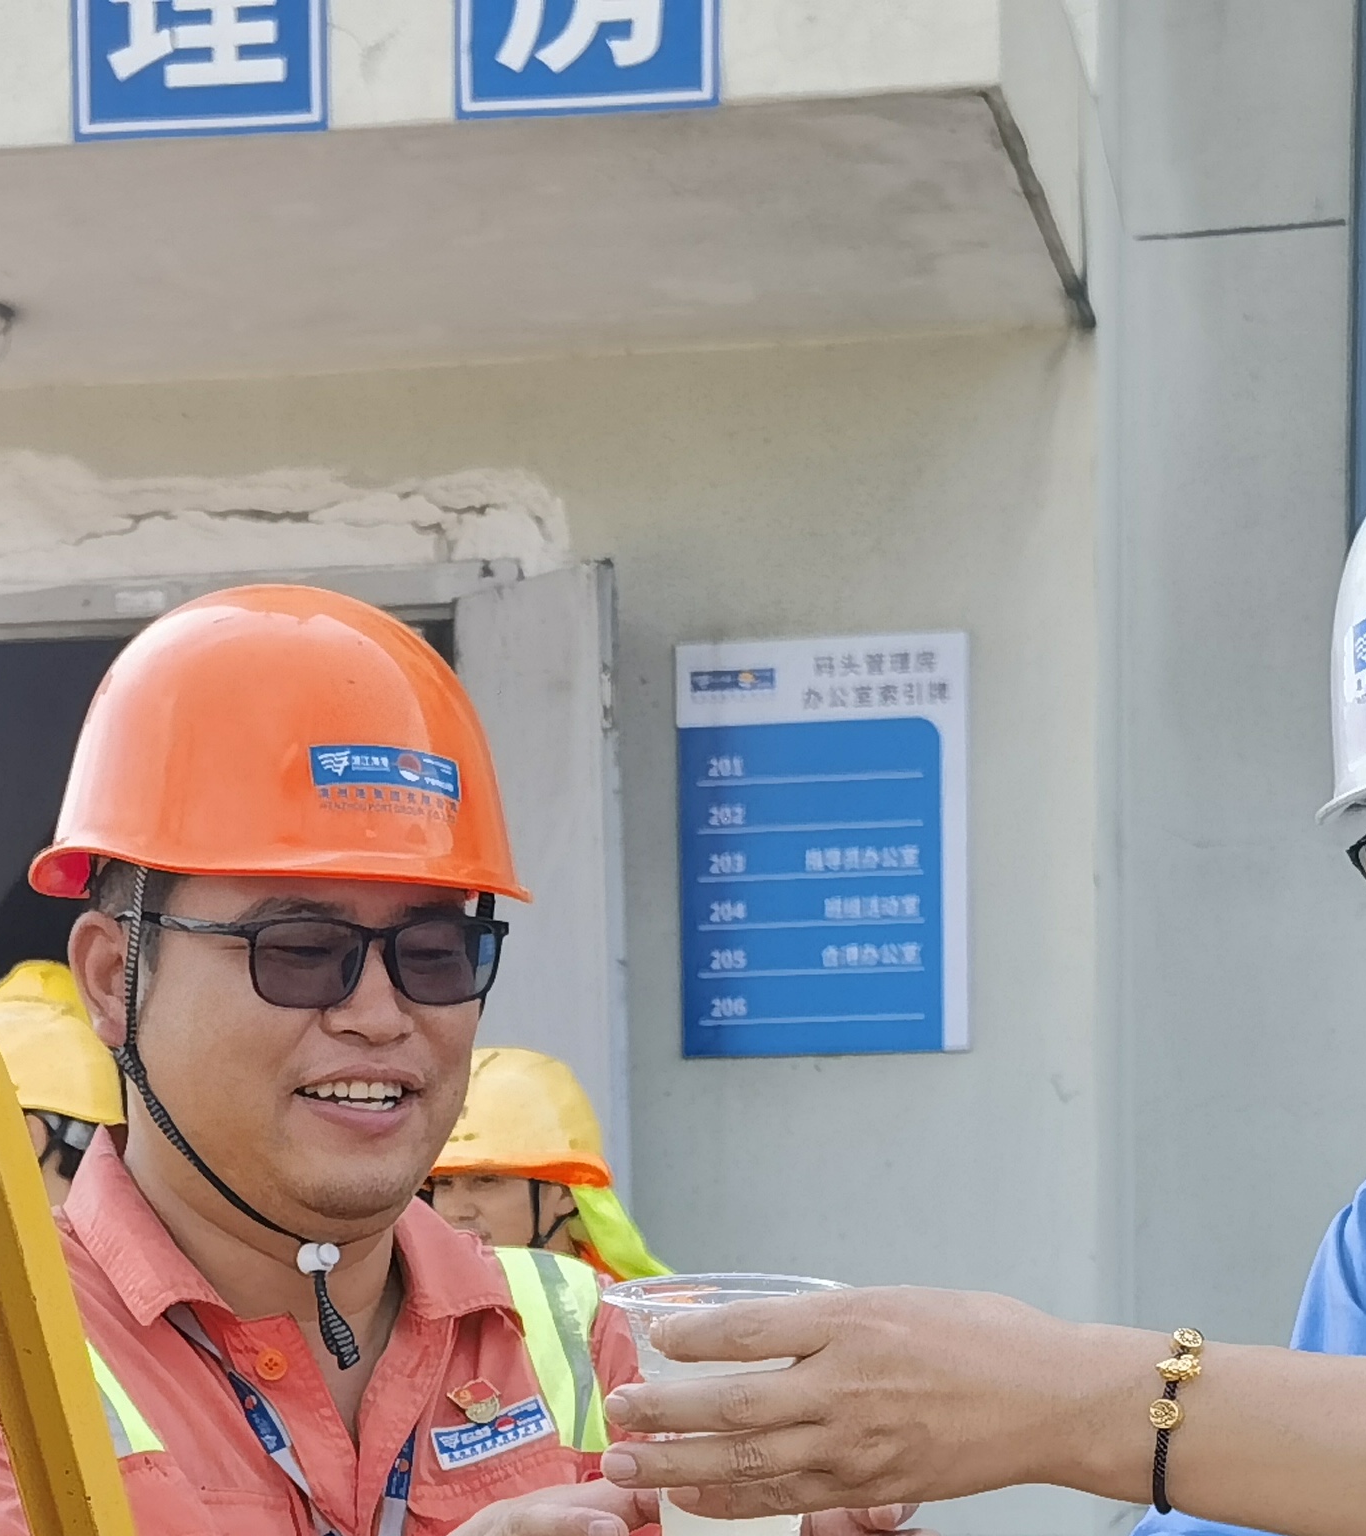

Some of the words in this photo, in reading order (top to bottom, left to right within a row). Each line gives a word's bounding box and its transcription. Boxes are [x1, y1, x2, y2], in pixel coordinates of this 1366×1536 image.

[707, 755, 744, 778] 201
[707, 803, 746, 827] 202
[708, 851, 747, 875] 203
[709, 899, 748, 923] 204
[709, 948, 748, 971] 205
[710, 996, 748, 1018] 206
